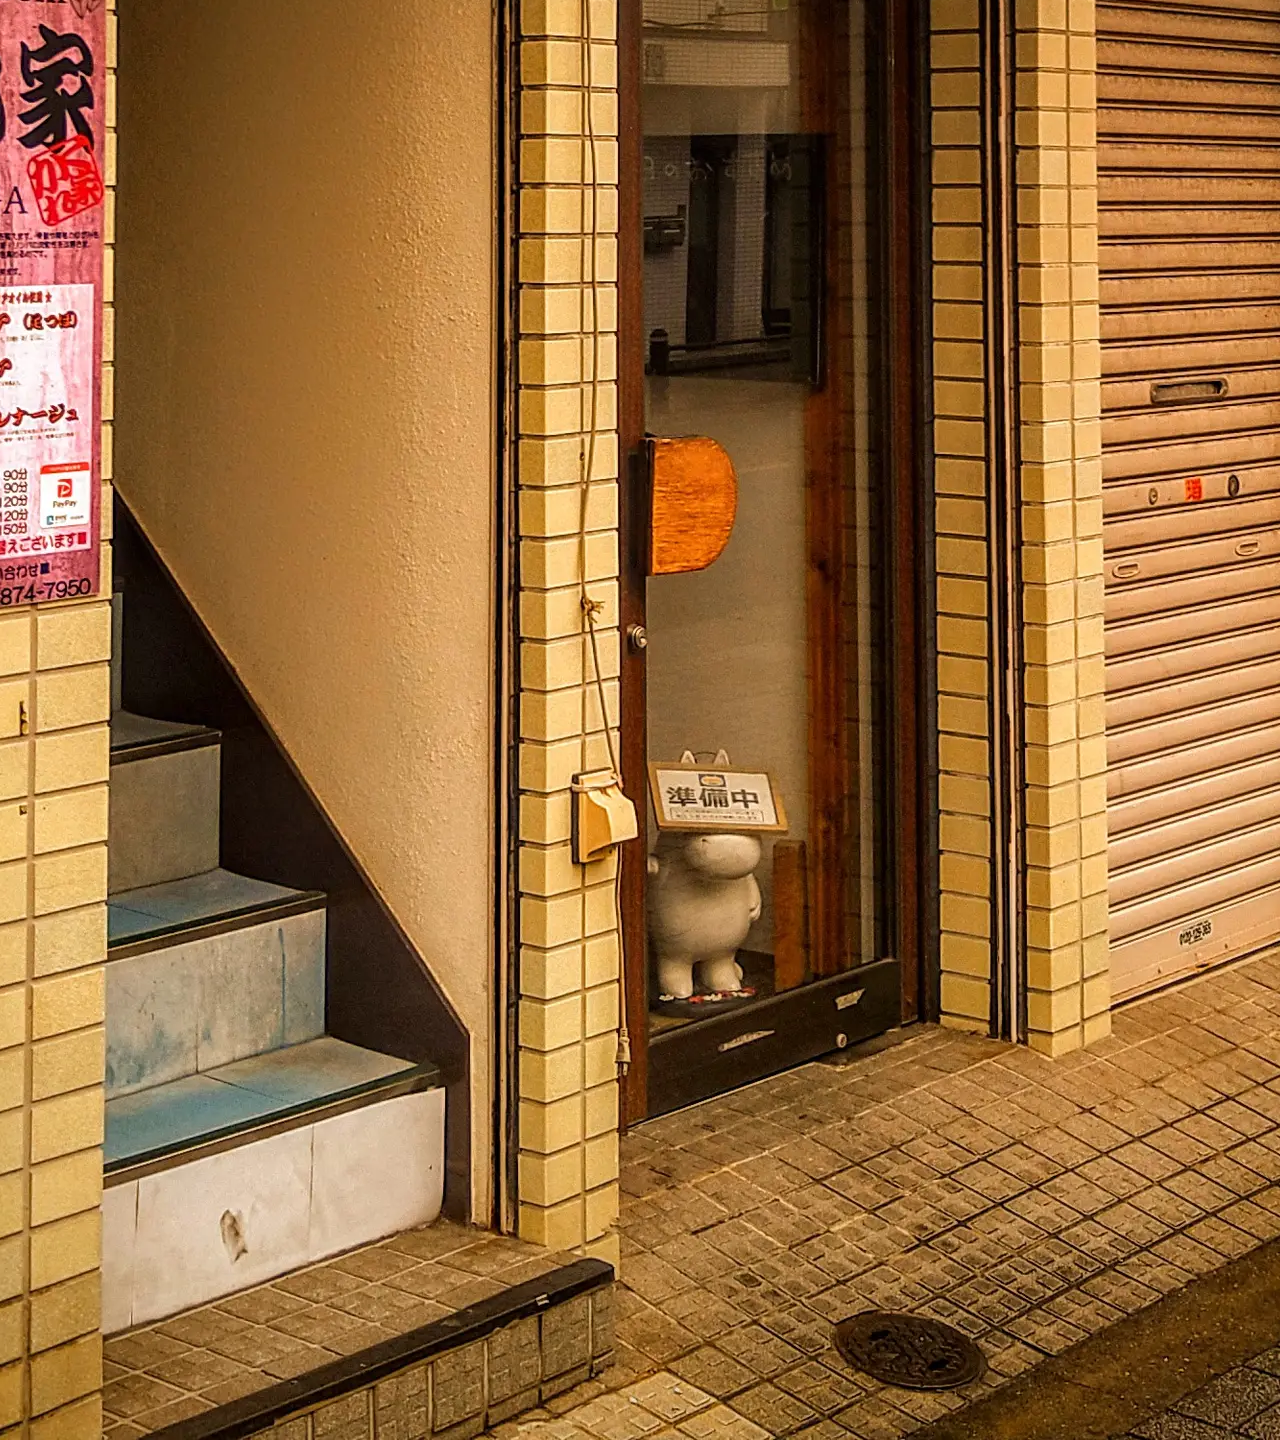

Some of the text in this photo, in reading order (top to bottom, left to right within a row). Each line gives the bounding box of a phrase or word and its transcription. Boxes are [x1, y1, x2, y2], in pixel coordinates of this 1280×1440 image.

[3, 468, 28, 481] 90分
[3, 482, 28, 495] 90分
[666, 786, 759, 808] 準備中
